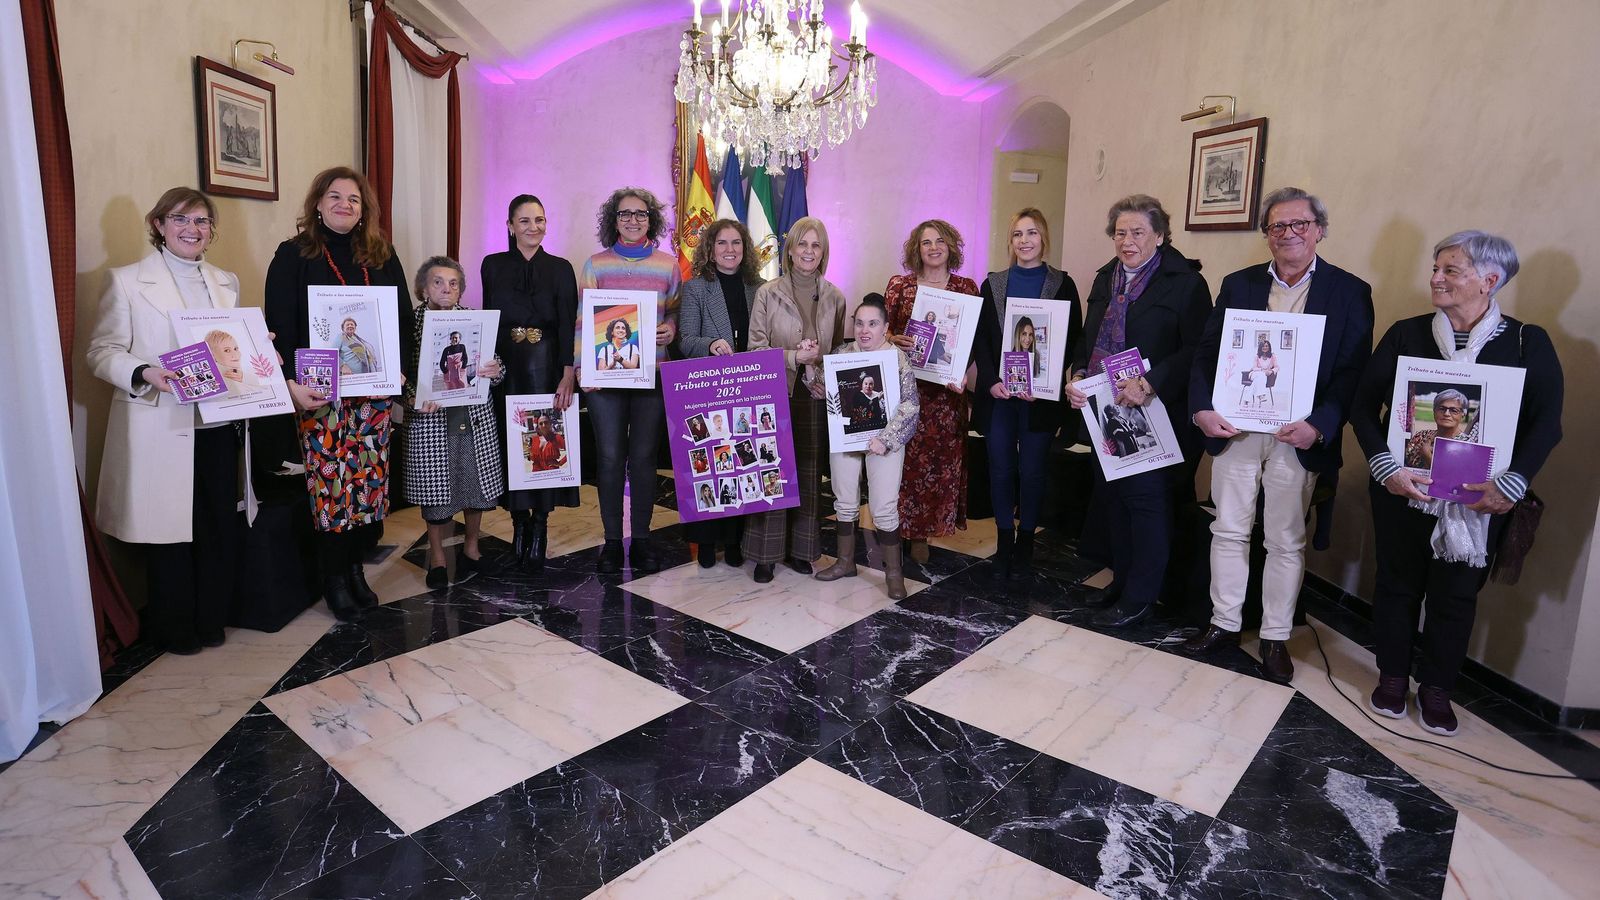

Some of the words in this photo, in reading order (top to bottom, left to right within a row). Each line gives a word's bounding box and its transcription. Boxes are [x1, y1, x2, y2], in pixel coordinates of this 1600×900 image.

[688, 369, 721, 380] AGENDA
[722, 364, 761, 375] IGUALDAD
[674, 381, 710, 392] Tributo
[720, 378, 734, 386] las
[737, 372, 778, 383] nuestras
[716, 386, 742, 398] 2026
[258, 401, 286, 409] FEBRERO
[708, 399, 735, 408] jerezanas
[750, 394, 772, 402] historia
[1259, 419, 1288, 427] NOVIEM
[1148, 453, 1176, 464] OCTUBRE
